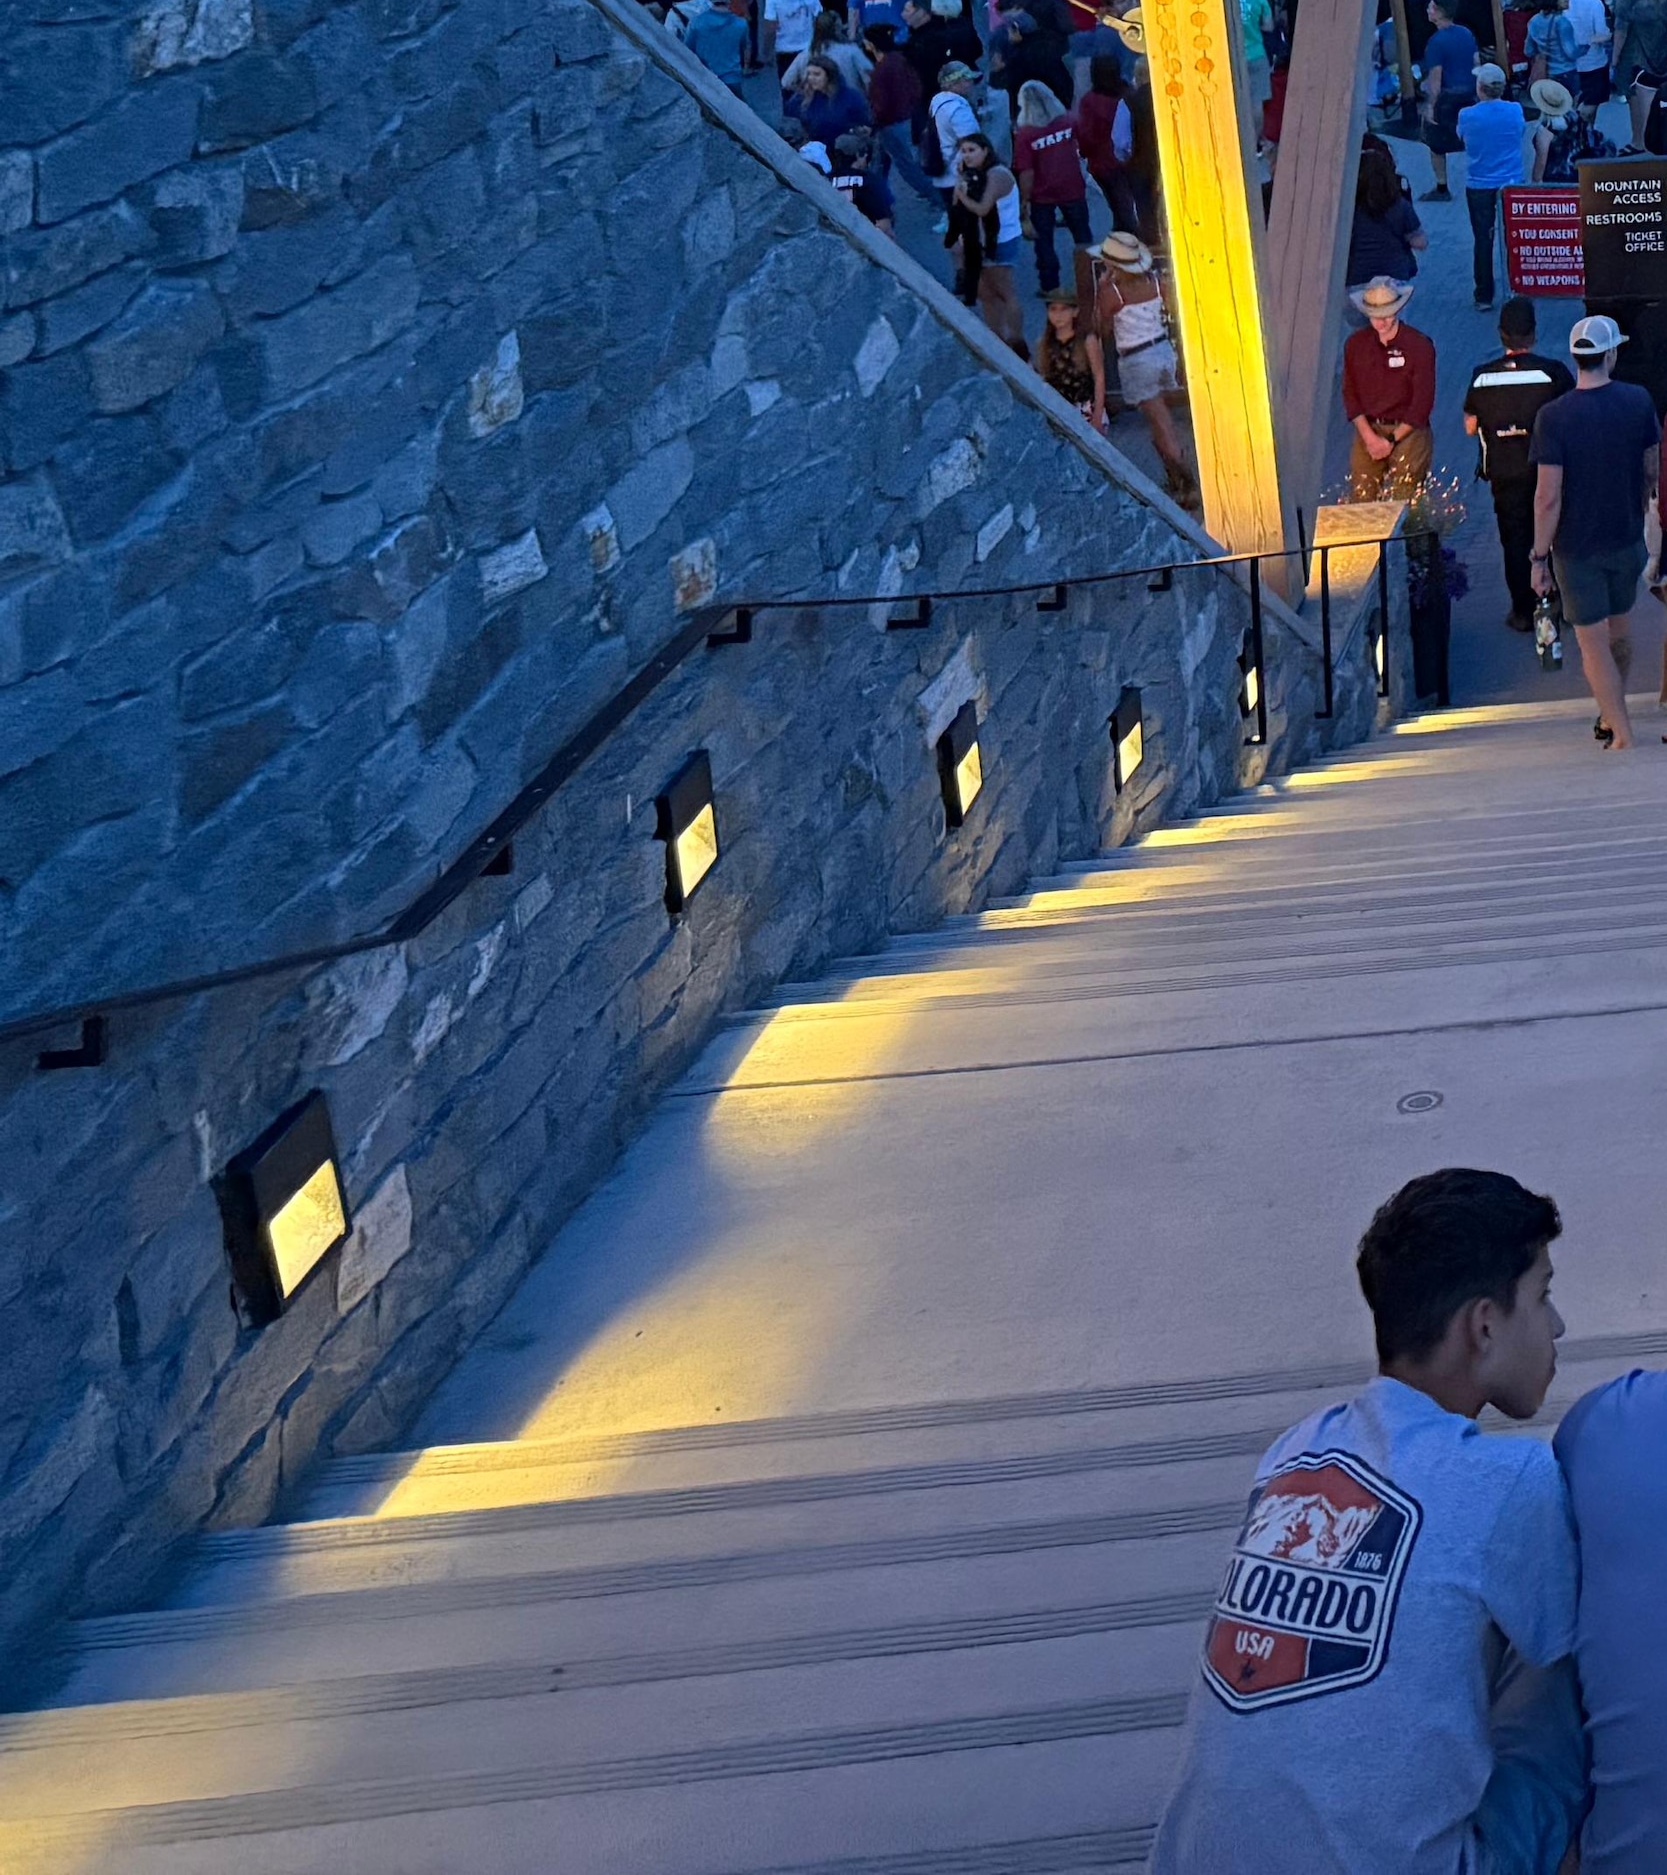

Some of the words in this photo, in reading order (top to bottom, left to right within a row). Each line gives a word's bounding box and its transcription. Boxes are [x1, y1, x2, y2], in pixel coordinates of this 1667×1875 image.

[1031, 127, 1073, 151] STAFF
[1594, 179, 1661, 193] MOUNTAIN
[1612, 192, 1662, 205] ACCESS
[1511, 202, 1525, 215] BY
[1527, 202, 1577, 215] ENTERING
[1586, 211, 1662, 225] RESTROOMS
[1519, 228, 1537, 239] YOU
[1538, 228, 1579, 239] CONSENT
[1624, 231, 1662, 242] TICKET
[1520, 245, 1533, 256] NO
[1533, 245, 1571, 256] OUTSIDE
[1624, 241, 1665, 253] OFFICE
[1522, 275, 1535, 286] NO
[1536, 275, 1580, 286] WEAPONS
[1354, 1550, 1383, 1571] 1876
[1234, 1629, 1276, 1661] USA
